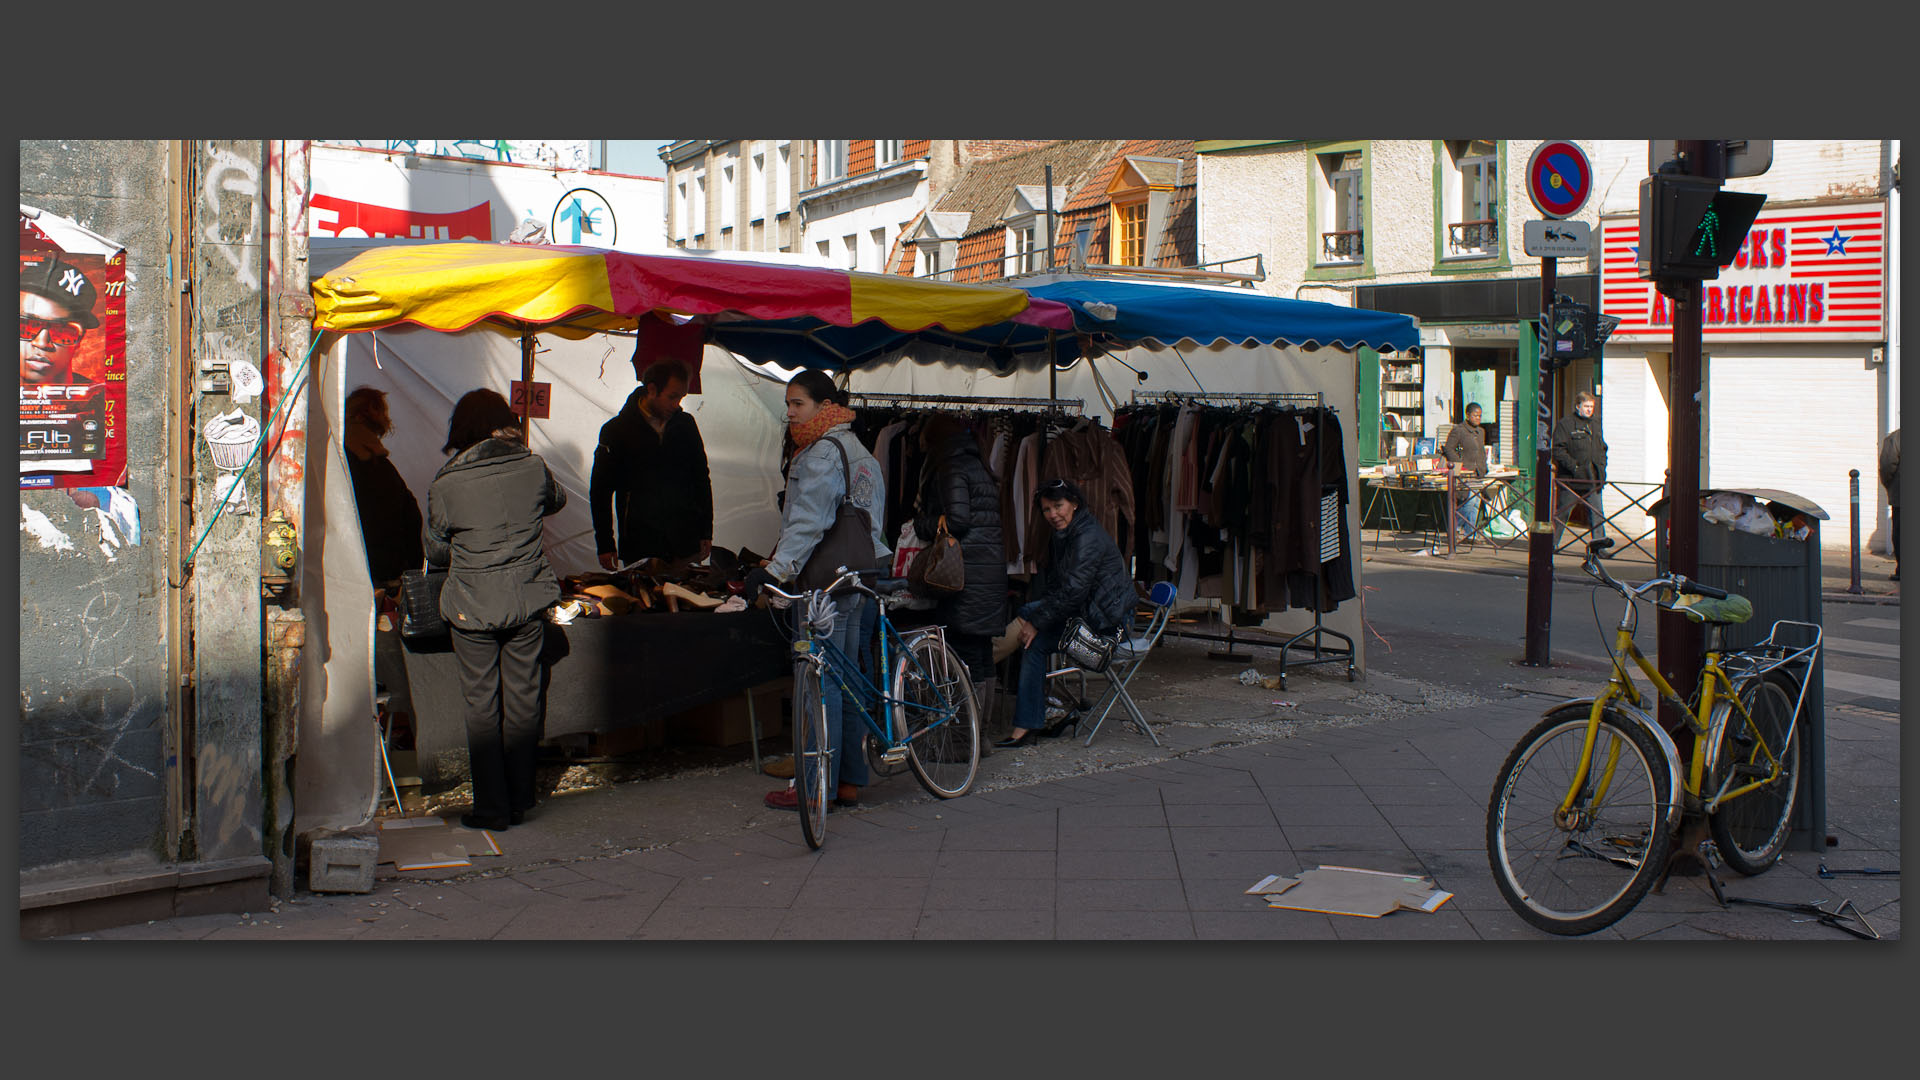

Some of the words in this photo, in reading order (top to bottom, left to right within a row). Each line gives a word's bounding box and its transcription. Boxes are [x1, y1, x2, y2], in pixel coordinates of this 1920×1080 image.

[1720, 228, 1786, 270] CKS
[58, 269, 84, 296] NY
[1651, 282, 1825, 325] ARICAINS
[105, 355, 114, 366] el
